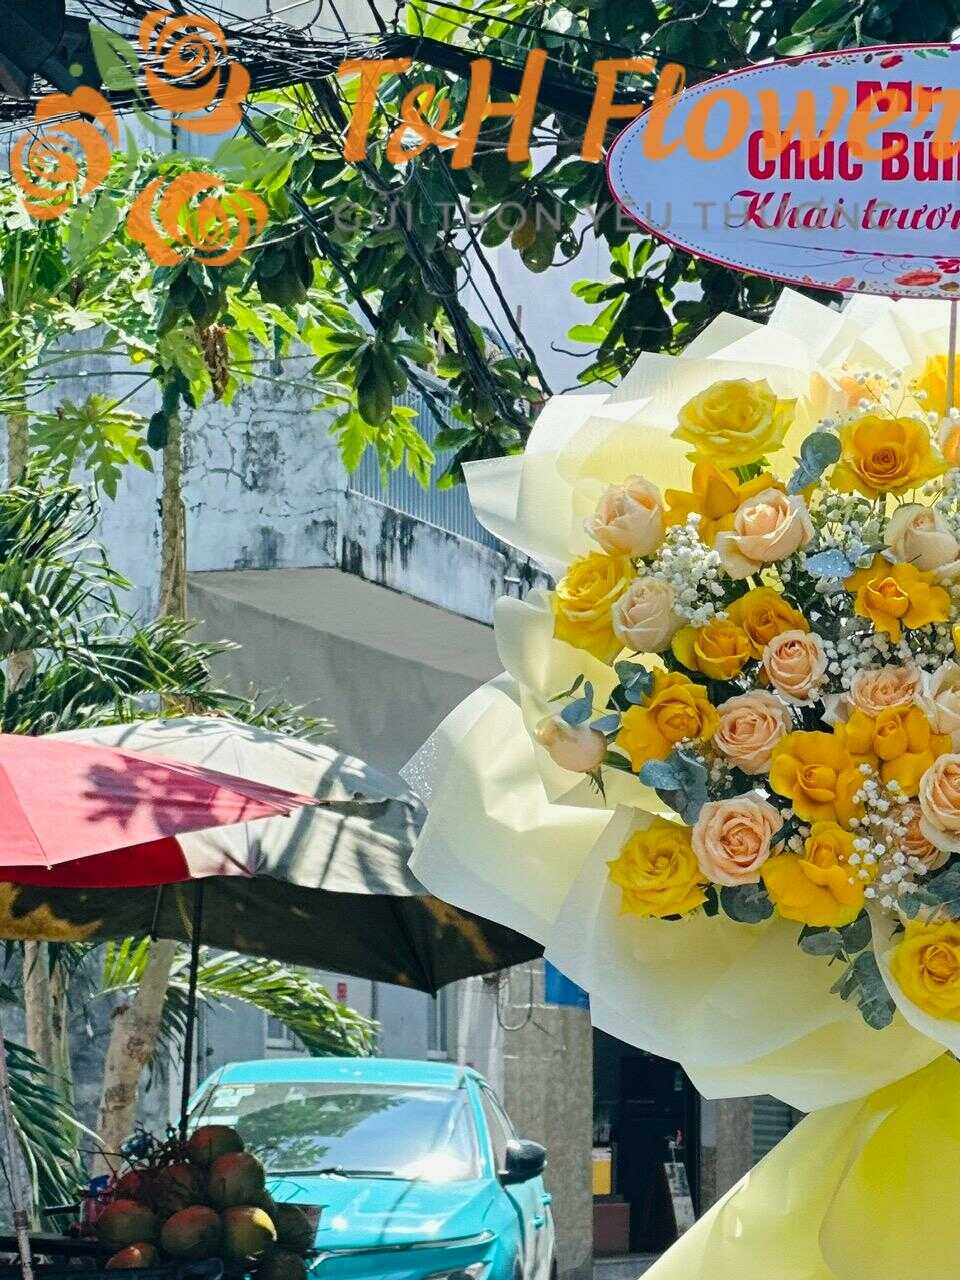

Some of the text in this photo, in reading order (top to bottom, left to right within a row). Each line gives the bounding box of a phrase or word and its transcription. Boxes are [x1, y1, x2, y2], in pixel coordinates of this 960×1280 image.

[855, 80, 943, 113] Mr
[747, 130, 864, 183] Chúc
[726, 190, 847, 231] Khai
